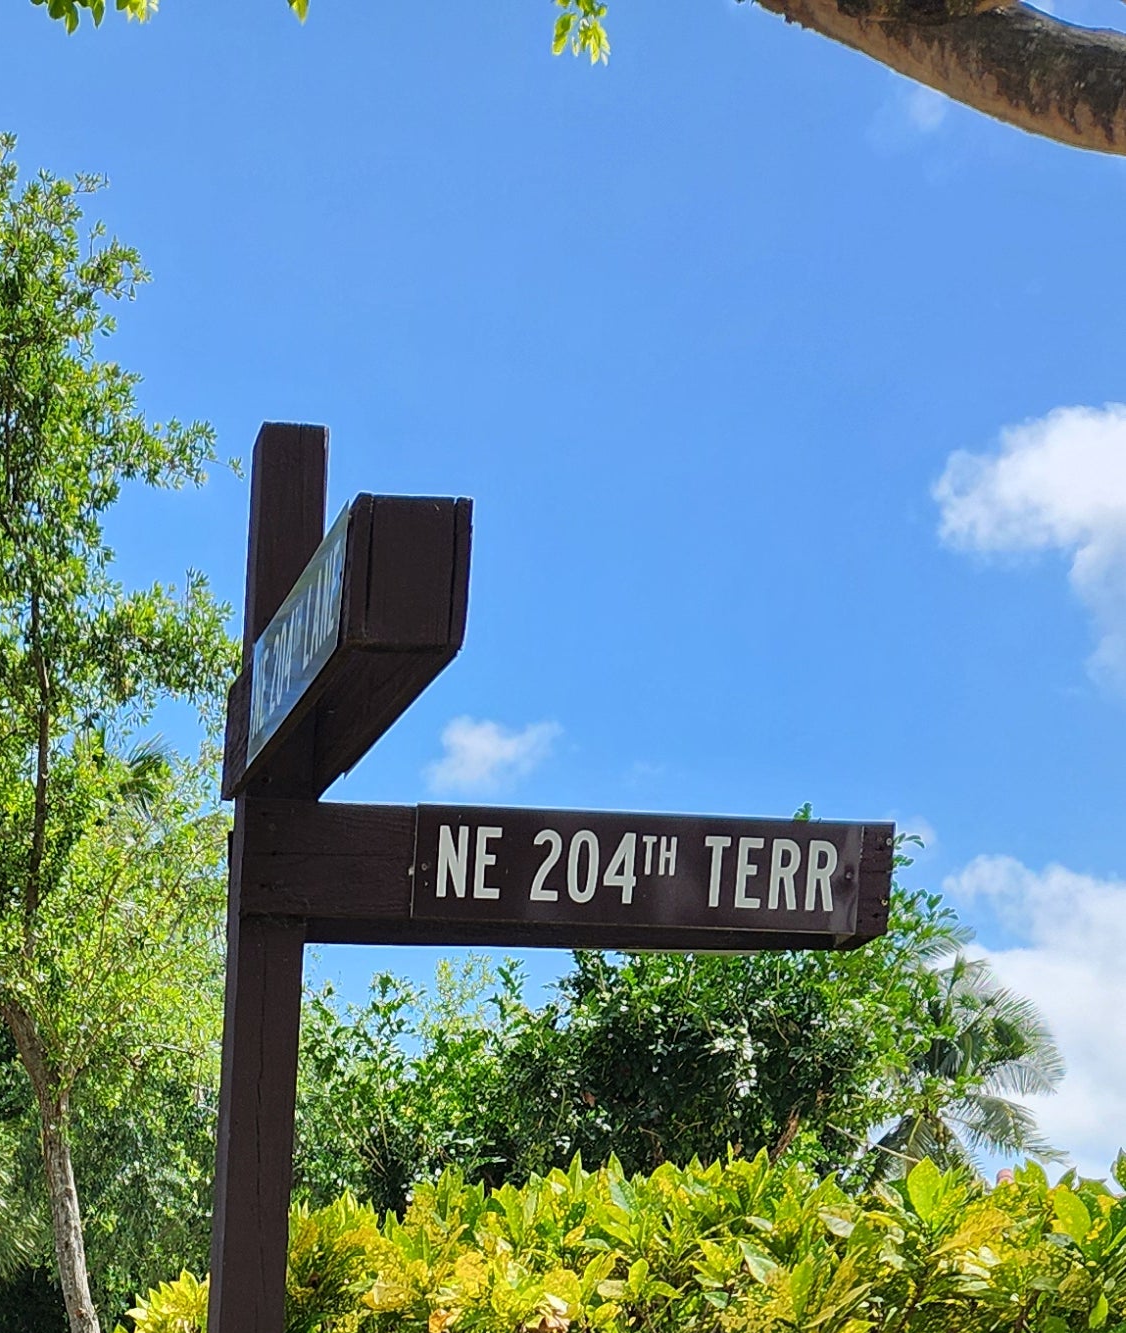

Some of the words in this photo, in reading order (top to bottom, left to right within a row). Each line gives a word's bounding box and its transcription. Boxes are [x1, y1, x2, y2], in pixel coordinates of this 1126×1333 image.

[302, 540, 341, 671] LANE
[436, 825, 503, 899] NE
[705, 836, 838, 912] TERR
